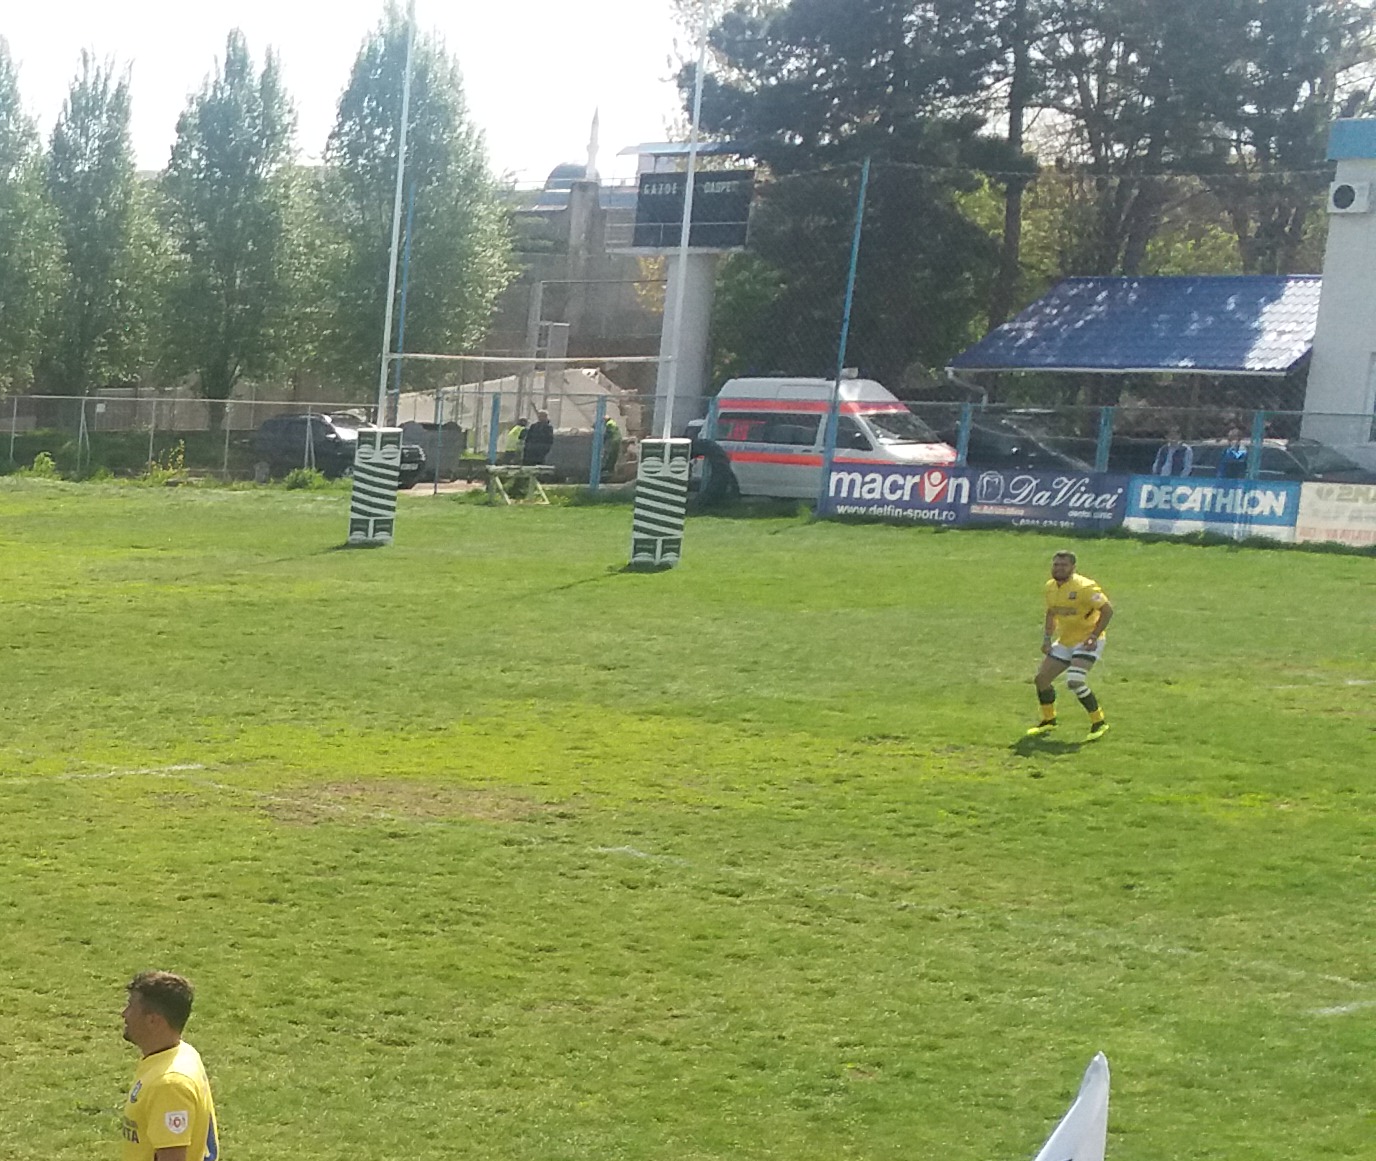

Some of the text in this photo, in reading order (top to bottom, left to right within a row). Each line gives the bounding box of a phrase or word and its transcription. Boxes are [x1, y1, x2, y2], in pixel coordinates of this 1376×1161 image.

[828, 470, 971, 504] macron
[1138, 483, 1287, 517] DECATHLON
[836, 504, 956, 521] www.delfin-sport.ro
